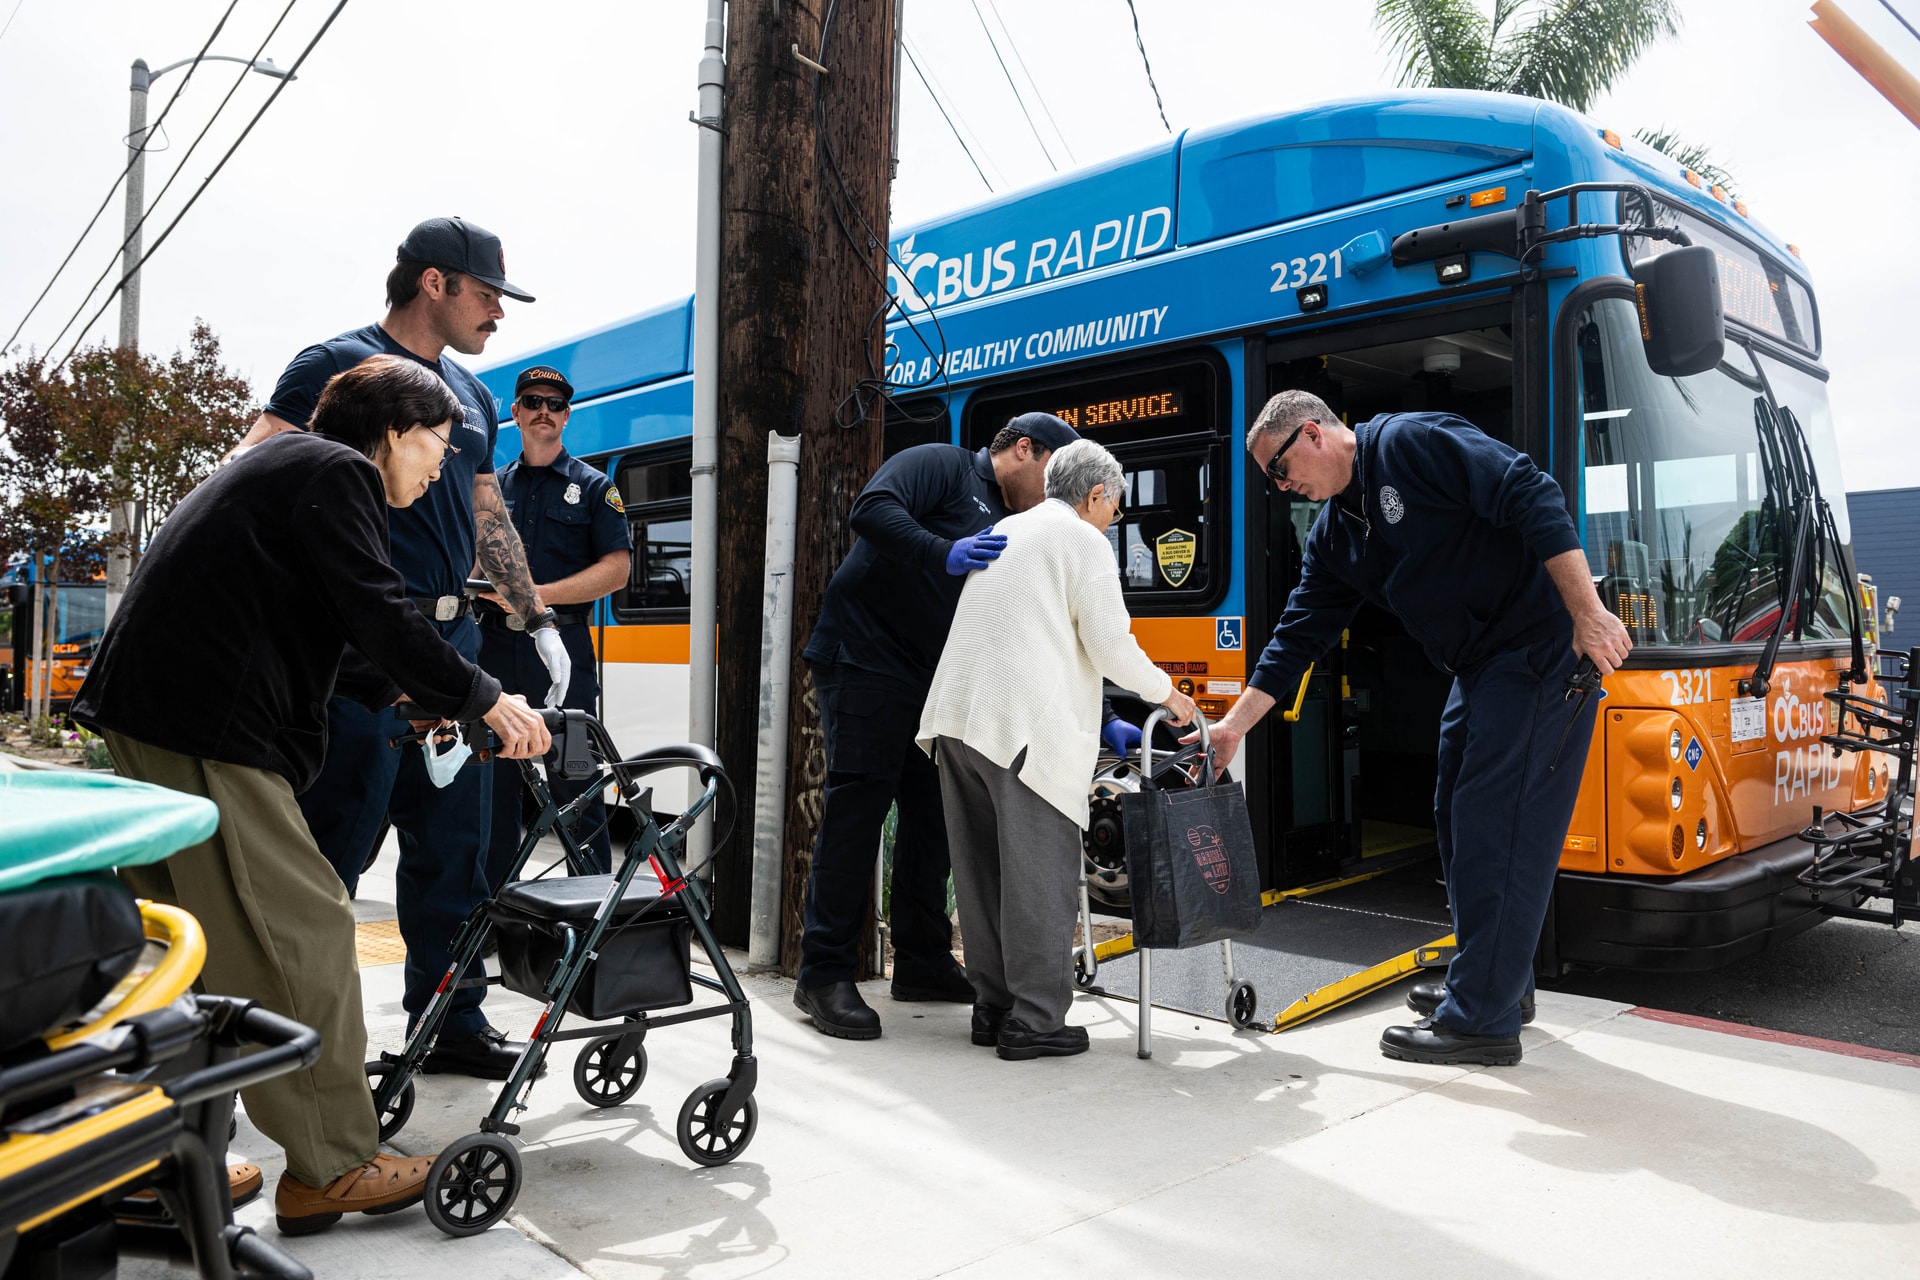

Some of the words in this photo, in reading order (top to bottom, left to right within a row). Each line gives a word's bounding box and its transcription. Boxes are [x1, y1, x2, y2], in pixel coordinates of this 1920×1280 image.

[1025, 206, 1171, 284] RAPID
[1270, 248, 1342, 293] 2321
[918, 356, 931, 381] A
[937, 337, 1022, 379] HEALTHY
[1025, 306, 1169, 359] COMMUNITY
[1085, 392, 1179, 426] SERVICE.
[1619, 593, 1658, 628] OCTA
[1188, 663, 1206, 673] RAMP
[1661, 669, 1712, 706] 2321
[1687, 748, 1700, 761] CNG
[1775, 743, 1841, 806] RAPID
